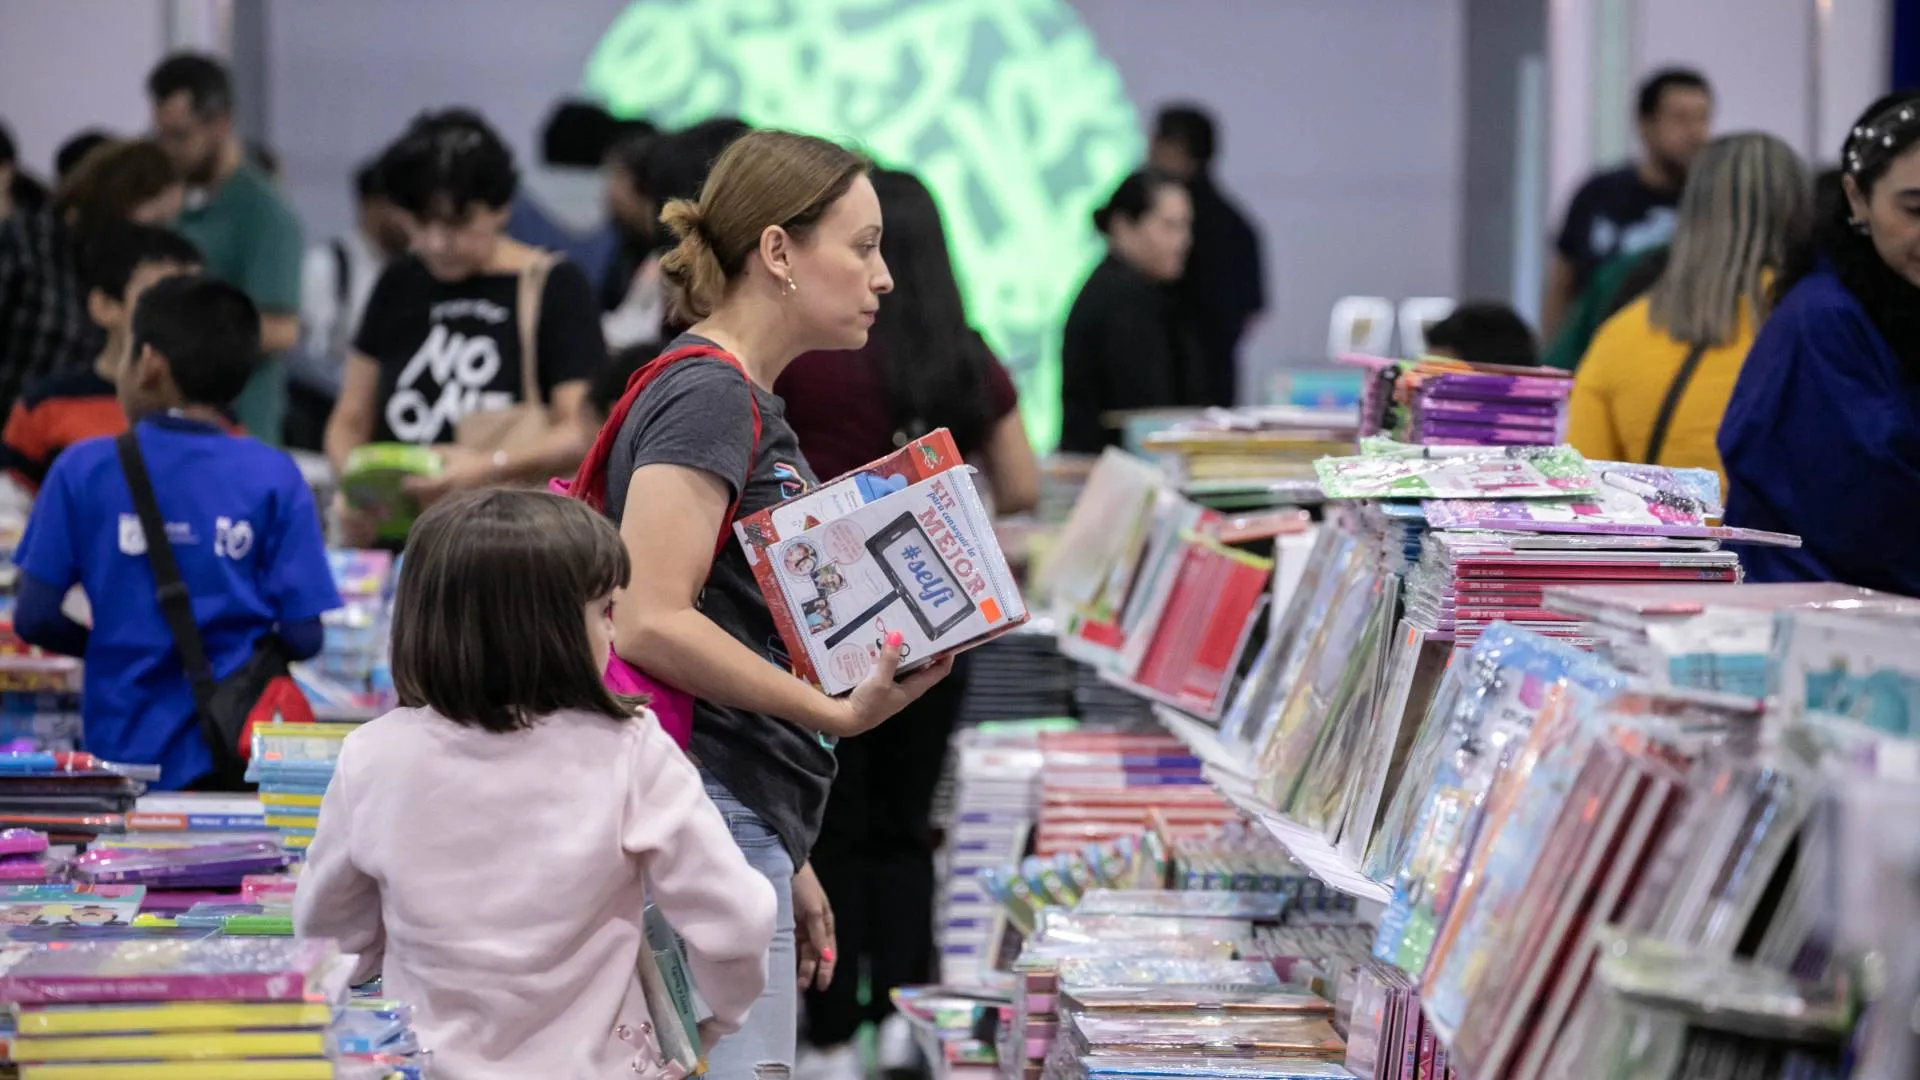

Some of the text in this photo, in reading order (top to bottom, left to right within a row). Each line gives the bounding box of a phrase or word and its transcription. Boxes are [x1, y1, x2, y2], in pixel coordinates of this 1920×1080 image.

[395, 323, 502, 391] NO
[925, 491, 946, 513] para
[930, 479, 956, 510] KIT
[901, 544, 956, 609] #selfi
[916, 504, 987, 598] MEJOR
